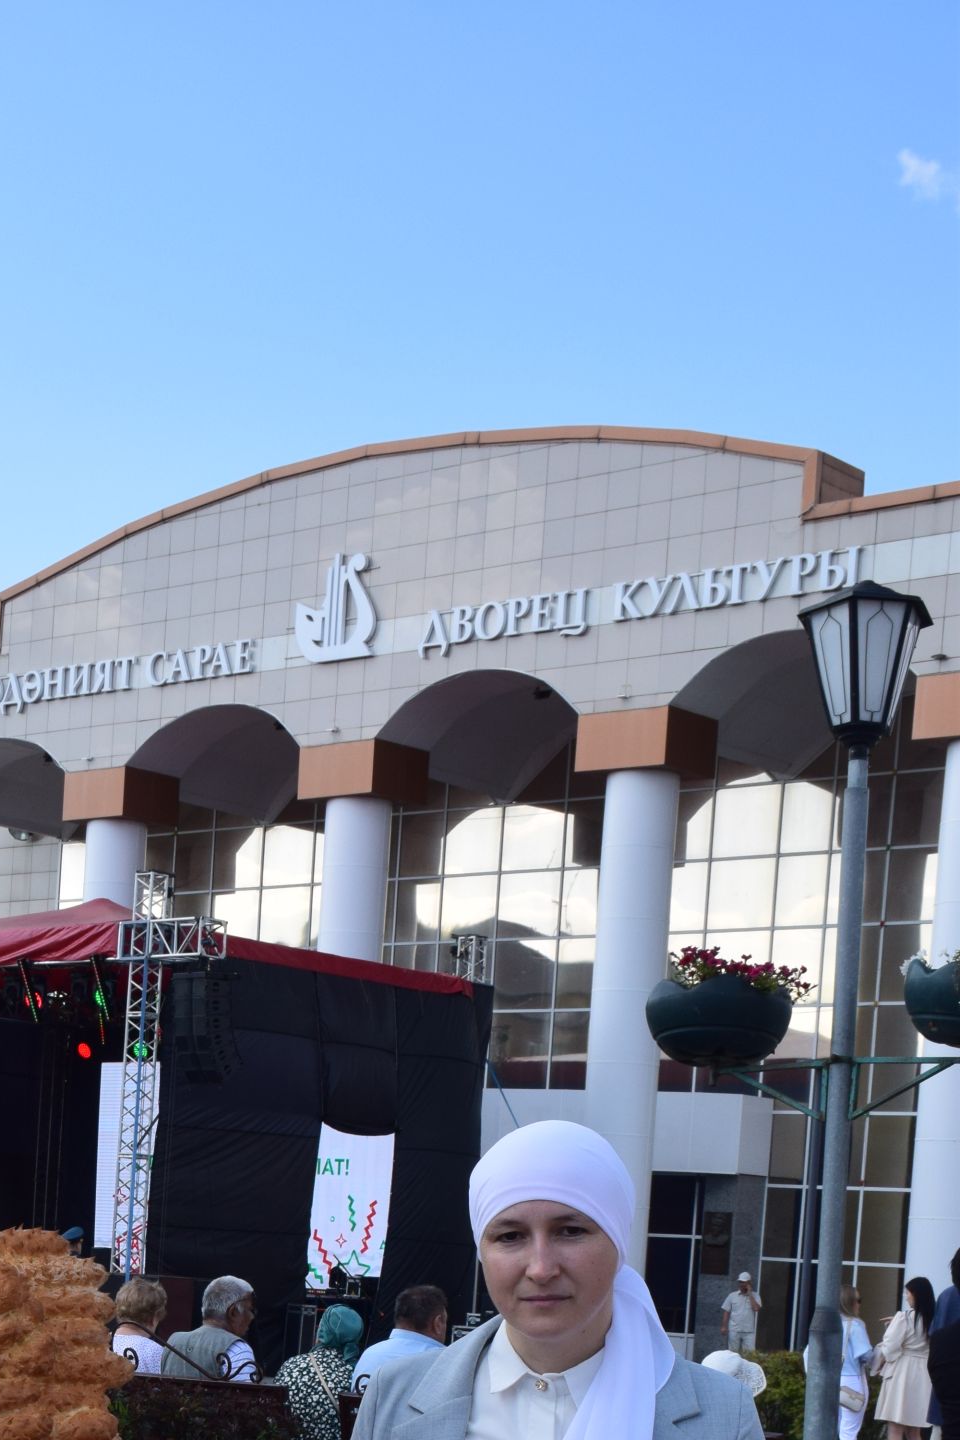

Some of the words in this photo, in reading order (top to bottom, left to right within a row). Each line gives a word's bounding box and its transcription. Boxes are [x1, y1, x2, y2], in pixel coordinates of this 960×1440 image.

[417, 588, 590, 659] ДВОРЕЦ
[613, 546, 863, 622] КУЛЬТУРЫ
[145, 639, 257, 687] САРАЕ
